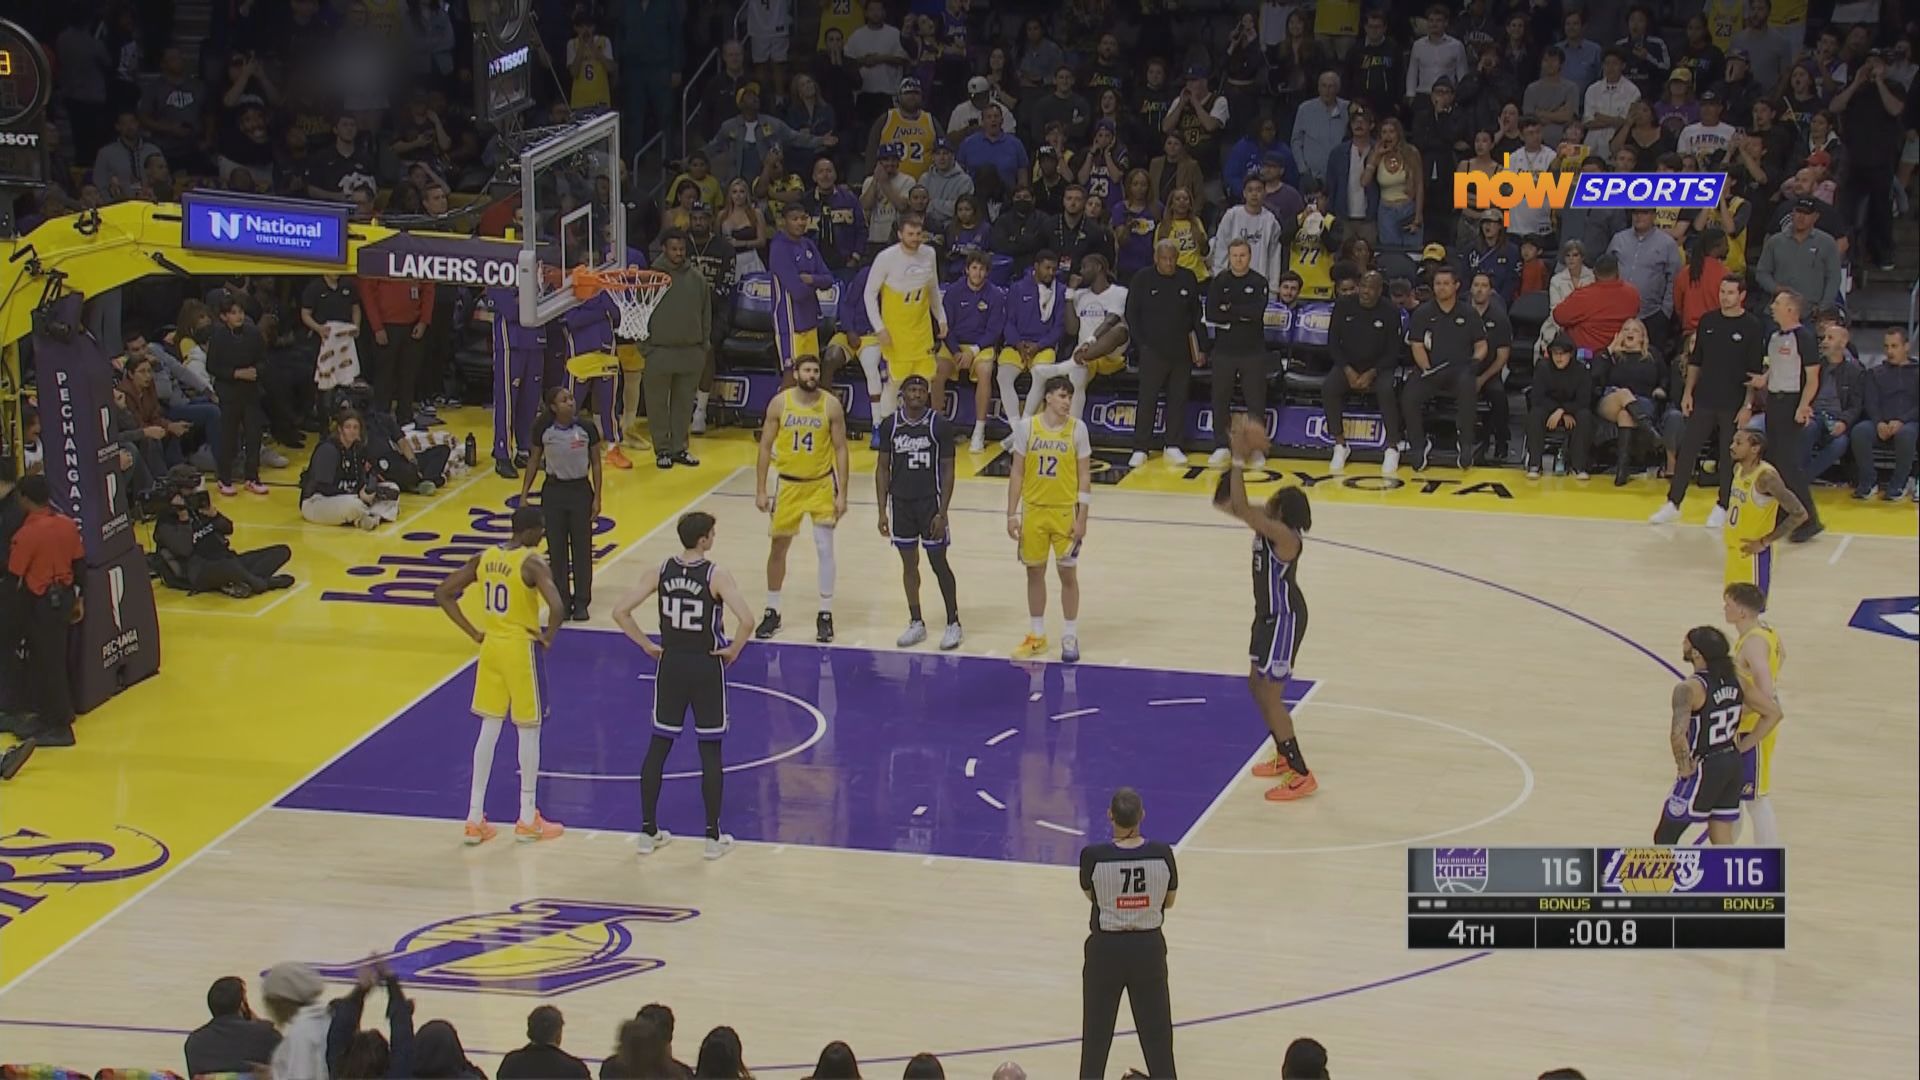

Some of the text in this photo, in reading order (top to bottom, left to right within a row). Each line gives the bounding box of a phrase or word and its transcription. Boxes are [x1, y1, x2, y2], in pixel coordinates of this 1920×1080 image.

[500, 46, 529, 73] TISSOT
[1089, 176, 1110, 198] 23
[246, 214, 322, 238] National
[255, 233, 312, 248] UNIVERSITY
[1300, 246, 1320, 265] 77
[388, 252, 520, 287] LAKERS.CO
[792, 431, 813, 451] 14
[1031, 437, 1068, 453] LAKERS
[1038, 455, 1058, 477] 12
[485, 581, 508, 613] 10
[662, 596, 703, 631] 42
[1709, 703, 1742, 746] 22
[1119, 867, 1146, 893] 72
